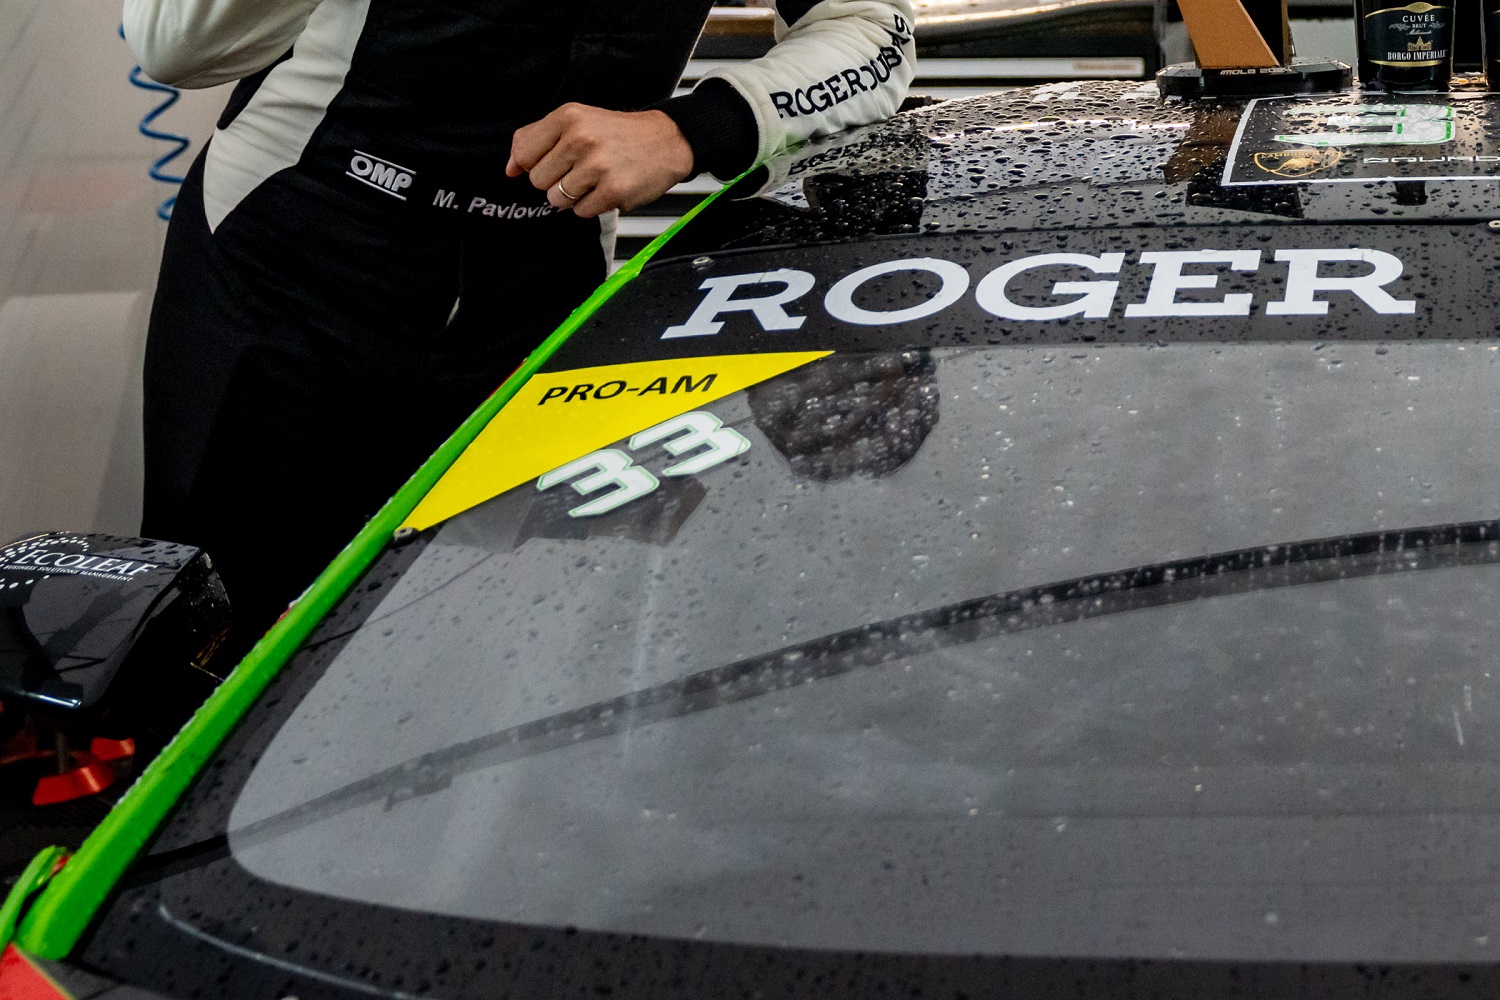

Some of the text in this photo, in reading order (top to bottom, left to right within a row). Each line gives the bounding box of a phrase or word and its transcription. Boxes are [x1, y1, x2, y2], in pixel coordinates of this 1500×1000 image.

[1388, 50, 1446, 60] BORGO IMPERIALE
[769, 68, 867, 119] ROGER
[350, 155, 412, 192] OMP
[433, 189, 459, 209] M.
[660, 248, 1416, 340] ROGER
[537, 373, 718, 406] PRO-AM
[536, 410, 751, 518] 33
[12, 549, 158, 576] ECOLEAF
[37, 566, 78, 575] SOLUTIONS
[79, 571, 134, 582] MANAGEMENT
